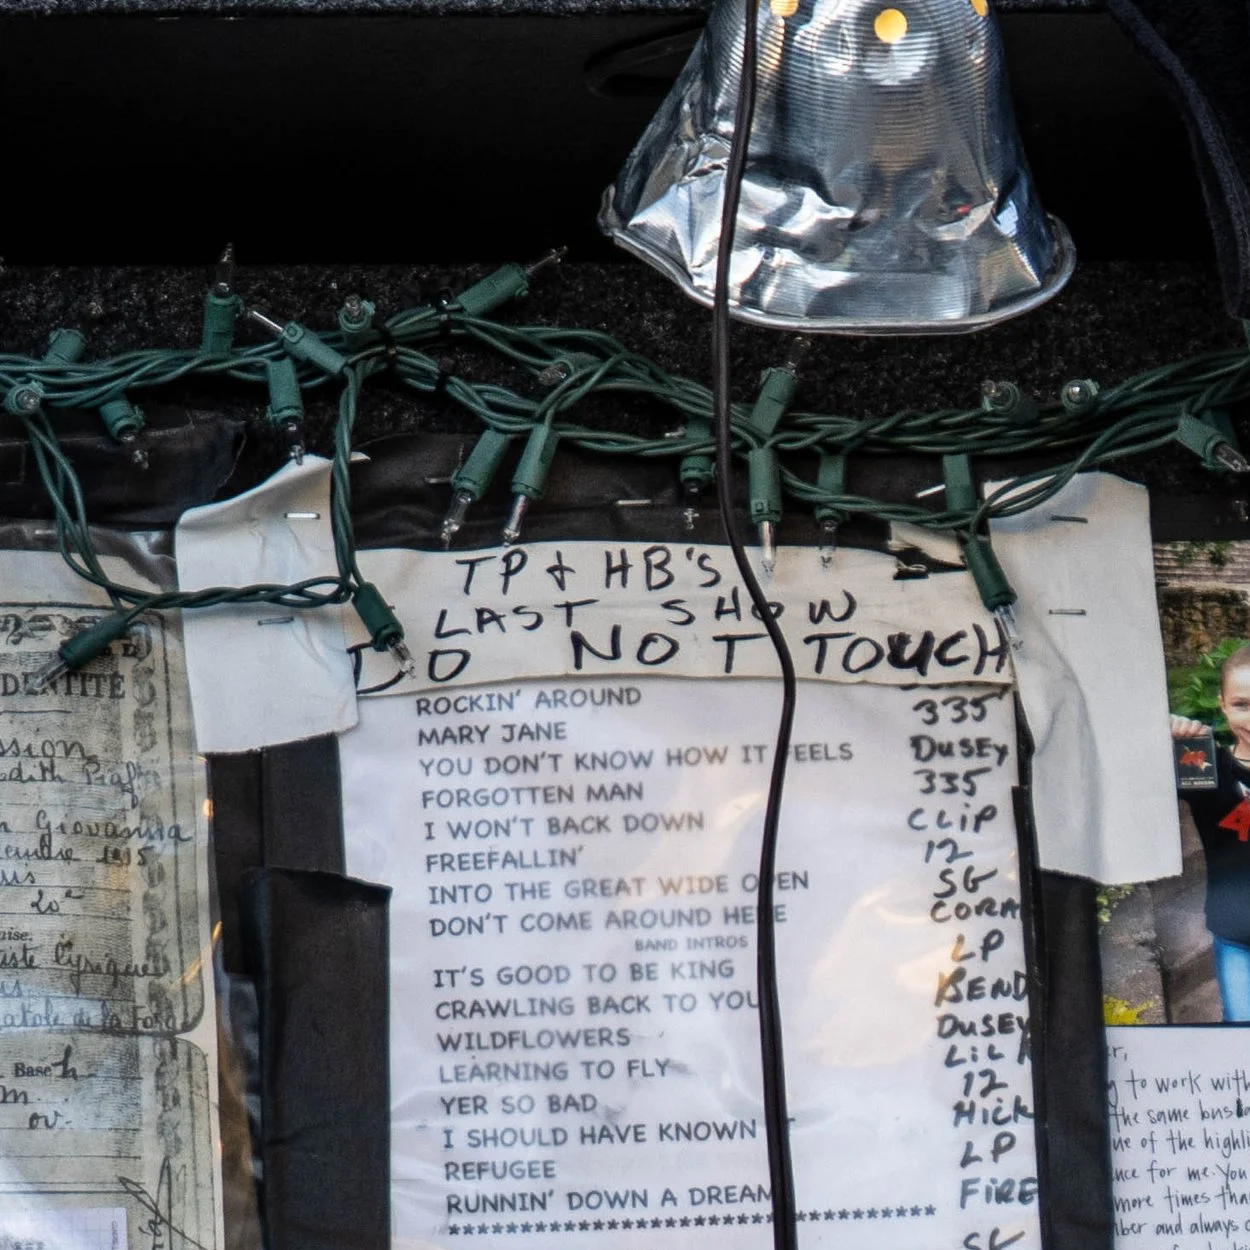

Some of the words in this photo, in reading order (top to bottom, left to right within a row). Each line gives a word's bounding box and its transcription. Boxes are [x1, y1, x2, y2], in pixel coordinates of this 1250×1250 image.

[455, 548, 527, 595] TP
[605, 546, 721, 591] HB'S
[435, 599, 599, 639] LAST
[661, 586, 857, 625] SHOW
[346, 640, 471, 694] DO
[570, 624, 769, 673] NOT
[803, 617, 1011, 676] TOUCH
[416, 689, 521, 716] ROCKIN'
[535, 687, 641, 708] AROUND
[912, 690, 1006, 725] 335
[418, 725, 490, 746] MARY
[501, 722, 567, 743] JANE
[420, 758, 473, 777] YOU
[484, 752, 563, 775] DON'T
[575, 750, 653, 771] KNOW
[667, 746, 728, 767] HOW
[741, 745, 768, 764] IT
[786, 742, 853, 762] EELS
[422, 785, 574, 808] FORGOTTEN
[587, 782, 643, 802] MAN
[913, 767, 992, 796] 335
[424, 822, 435, 841] I
[447, 816, 535, 839] WON'T
[548, 815, 611, 836] BACK
[624, 812, 704, 833] DOWN
[426, 845, 584, 873] FREEFALLIN'
[924, 838, 973, 863] 12
[429, 884, 492, 905] INTO
[504, 881, 552, 901] THE
[565, 877, 646, 898] GREAT
[658, 875, 728, 895] WIDE
[741, 870, 809, 892] OEN
[429, 913, 508, 937] DON'T
[520, 911, 592, 933] COME
[605, 908, 711, 929] AROUND
[723, 904, 787, 925] HEE
[635, 939, 678, 952] BAND
[686, 935, 748, 950] INTROS
[952, 929, 1004, 961] LP
[434, 966, 485, 988] IT'S
[497, 965, 570, 985] GOOD
[583, 963, 617, 984] TO
[630, 962, 659, 982] BE
[672, 959, 734, 980] KING
[436, 996, 575, 1020] CRAWLING
[587, 995, 650, 1015] BACK
[663, 994, 697, 1013] TO
[437, 1027, 631, 1052] WILDFLOWERS
[439, 1062, 569, 1084] LEARNING
[580, 1060, 614, 1079] TO
[628, 1058, 670, 1078] FLY
[963, 1068, 1008, 1098] 12
[1126, 1069, 1146, 1099] to
[1155, 1070, 1201, 1095] work
[440, 1096, 488, 1116] YER
[501, 1094, 535, 1114] SO
[548, 1093, 597, 1114] BAD
[443, 1128, 454, 1149] I
[468, 1127, 568, 1147] SHOULD
[580, 1123, 647, 1144] HAVE
[660, 1119, 757, 1142] KNOWN
[1141, 1130, 1158, 1154] of
[1167, 1129, 1196, 1154] the
[960, 1131, 1017, 1168] LP
[444, 1160, 556, 1181] REFUGEE
[447, 1190, 553, 1215] RUNNIN'
[568, 1188, 648, 1211] DOWN
[660, 1187, 678, 1208] A
[689, 1183, 773, 1206] DREAM
